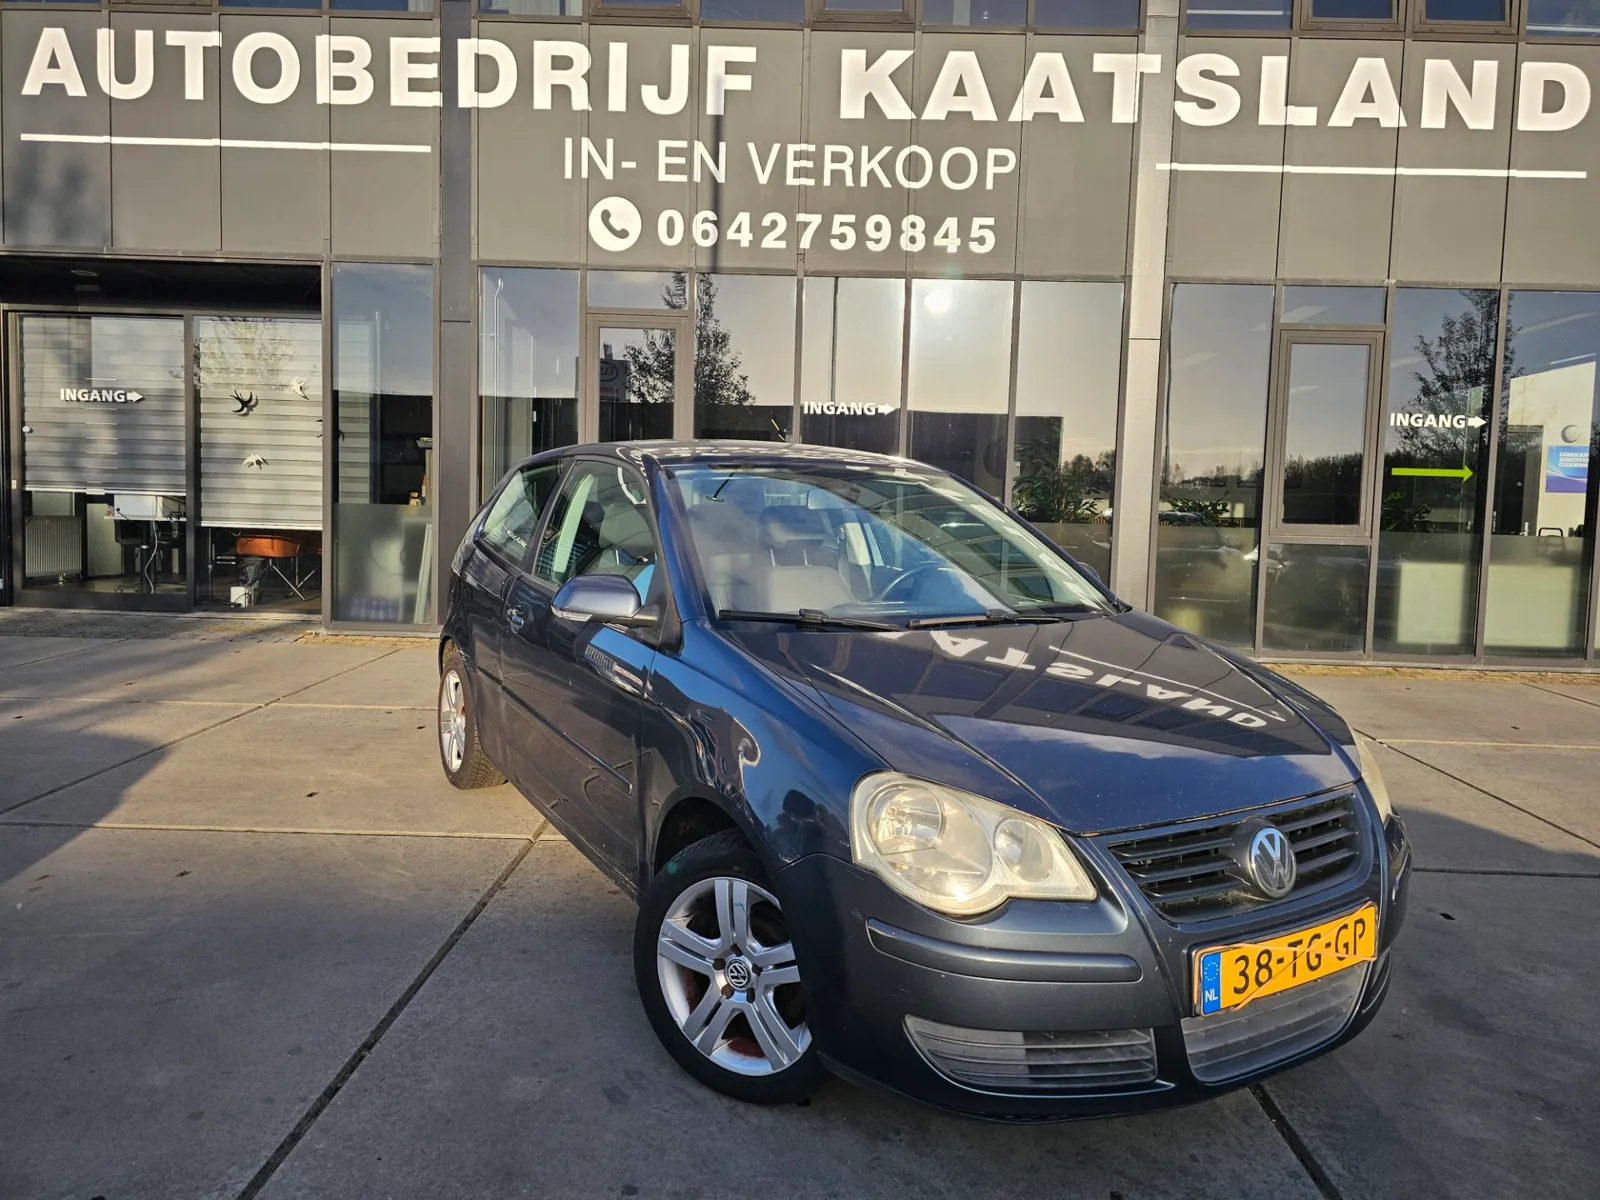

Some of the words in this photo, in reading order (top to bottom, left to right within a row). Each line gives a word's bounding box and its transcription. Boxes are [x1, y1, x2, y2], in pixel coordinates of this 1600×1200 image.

[20, 26, 758, 116] AUTOBEDRIJF
[839, 48, 1592, 132] KAATSLAND
[563, 136, 637, 180] IN-
[657, 139, 727, 184] EN
[747, 142, 1017, 191] VERKOOP
[656, 208, 997, 254] 0642759845
[60, 388, 126, 402] INGANG
[803, 401, 876, 415] INGANG
[1389, 412, 1466, 428] INGANG
[1232, 917, 1367, 995] 38-TG-GP
[1204, 987, 1219, 1003] NL
